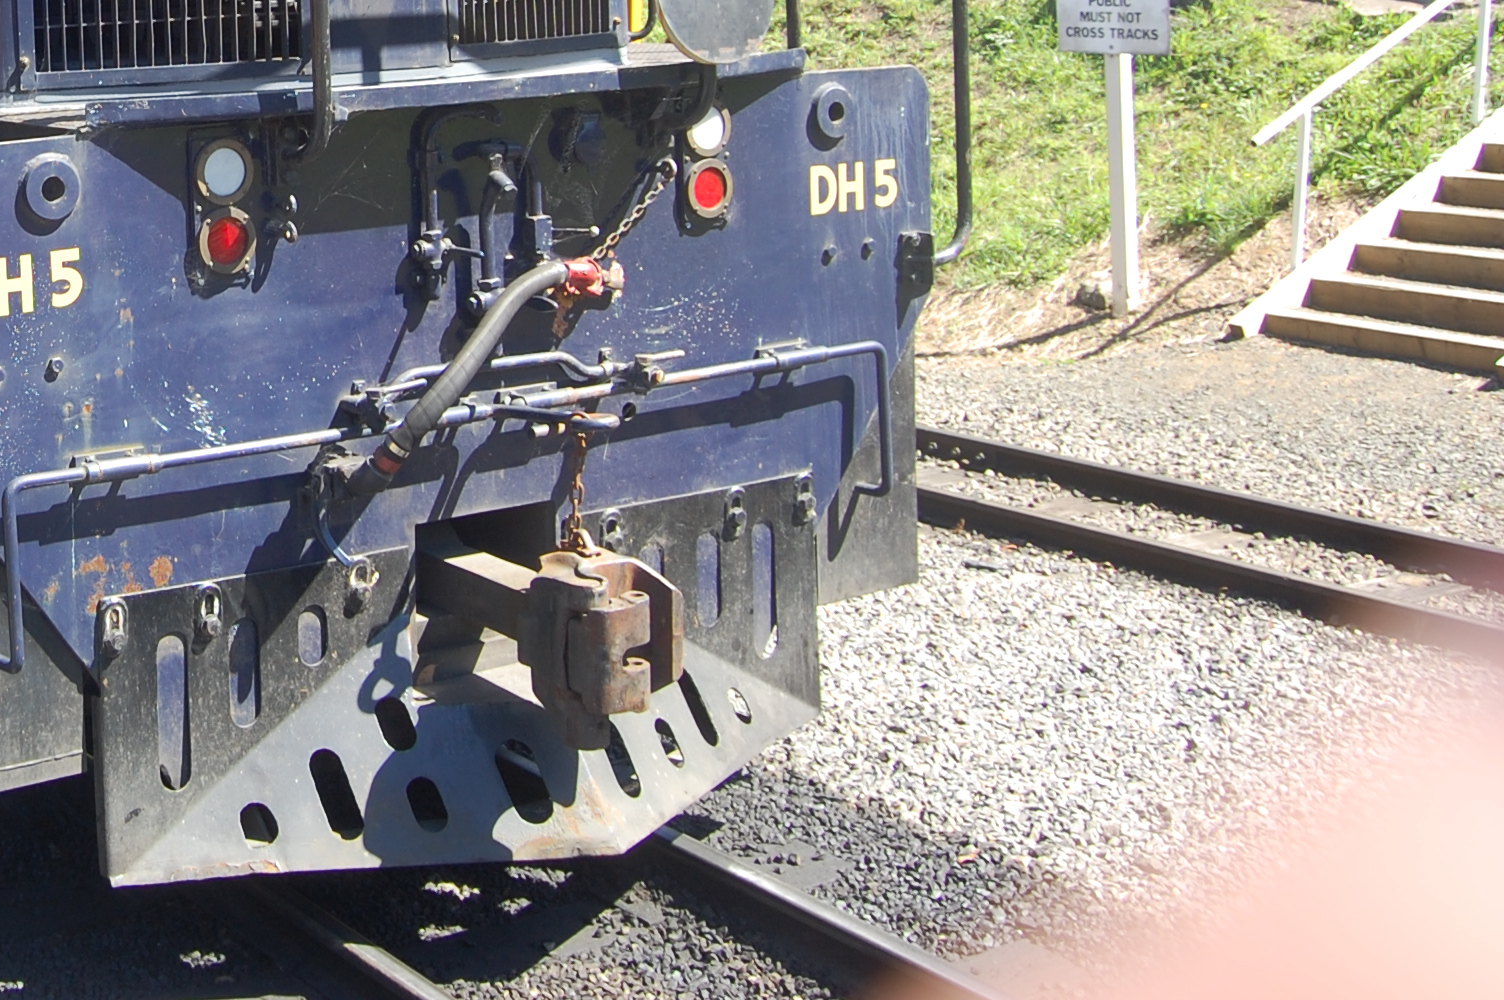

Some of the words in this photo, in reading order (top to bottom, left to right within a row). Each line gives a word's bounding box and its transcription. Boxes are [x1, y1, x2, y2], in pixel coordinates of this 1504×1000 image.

[1065, 26, 1105, 39] CROSS
[1109, 28, 1159, 40] TRACKS
[1079, 11, 1112, 23] MUST
[1117, 12, 1141, 24] NOT
[810, 161, 865, 216] DH
[874, 158, 898, 209] 5
[49, 247, 84, 308] 5
